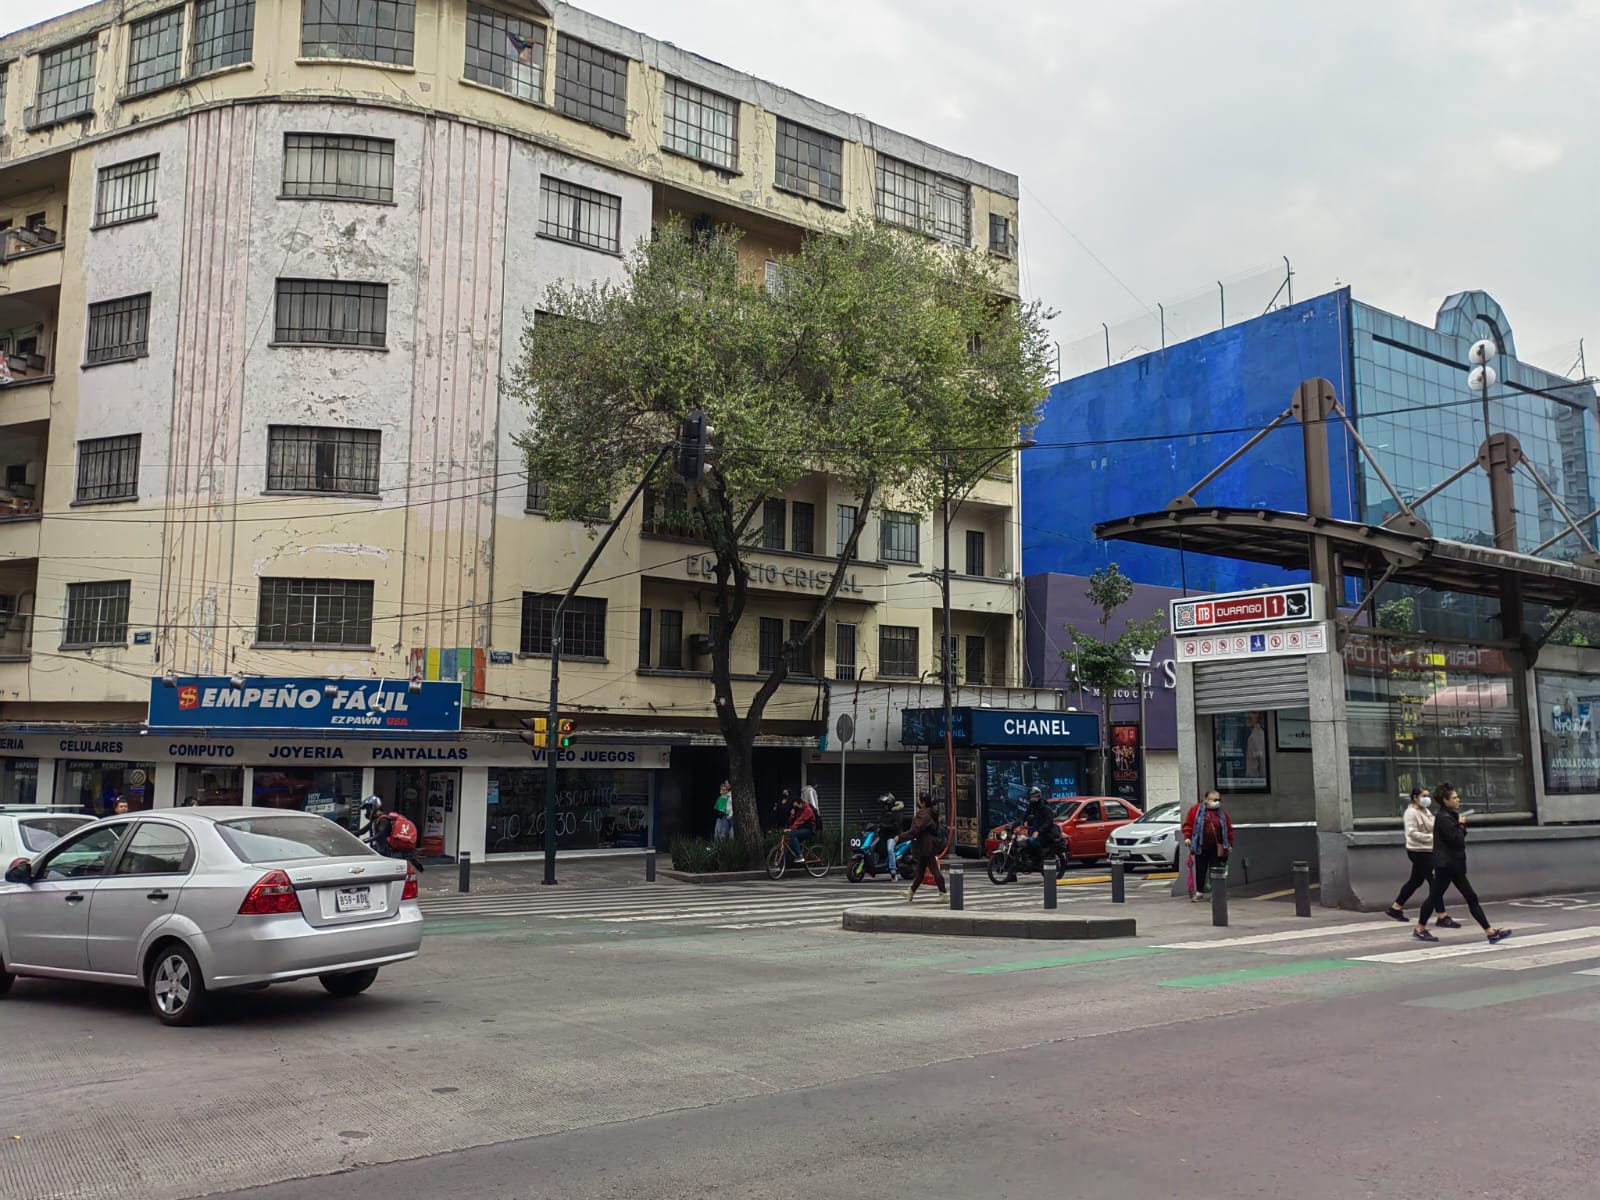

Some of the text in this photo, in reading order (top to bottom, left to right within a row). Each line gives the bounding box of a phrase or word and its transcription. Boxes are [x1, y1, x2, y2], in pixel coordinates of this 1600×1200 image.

[687, 554, 777, 583] EDCIO
[1217, 604, 1262, 617] DURANGO
[1271, 599, 1278, 614] 1
[201, 684, 321, 708] EMPEÑO
[332, 685, 408, 712] FÁCIL
[1093, 688, 1154, 701] MICO CTY
[386, 717, 408, 726] USA
[1004, 719, 1071, 736] CHANEL
[60, 740, 123, 753] CELULARES
[169, 744, 235, 757] COMPUTO
[269, 746, 344, 759] JOYERIA
[372, 747, 468, 760] PANTALLAS
[532, 749, 635, 762] VIEO JUEGOS
[1054, 778, 1075, 786] BLEU
